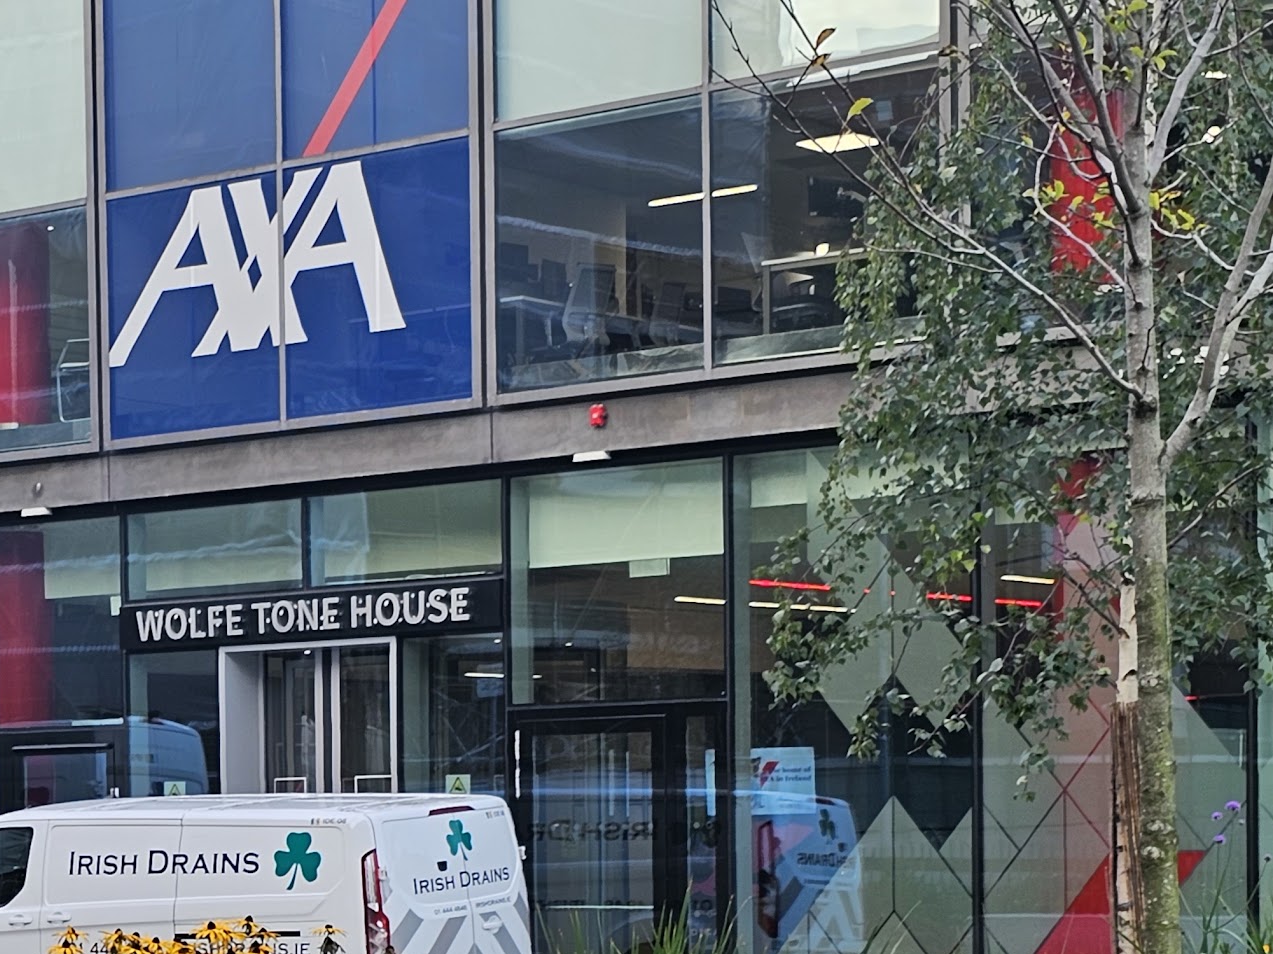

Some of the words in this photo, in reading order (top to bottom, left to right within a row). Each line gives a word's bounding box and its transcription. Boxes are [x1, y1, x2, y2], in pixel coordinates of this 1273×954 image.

[109, 160, 406, 367] AXA
[136, 604, 244, 642] WOLFE
[251, 597, 340, 635] TONE
[351, 586, 470, 629] HOUSE
[68, 851, 138, 876] IRISH
[148, 850, 260, 875] DRAINS
[413, 875, 455, 895] IRISH
[459, 867, 510, 888] DRAINS
